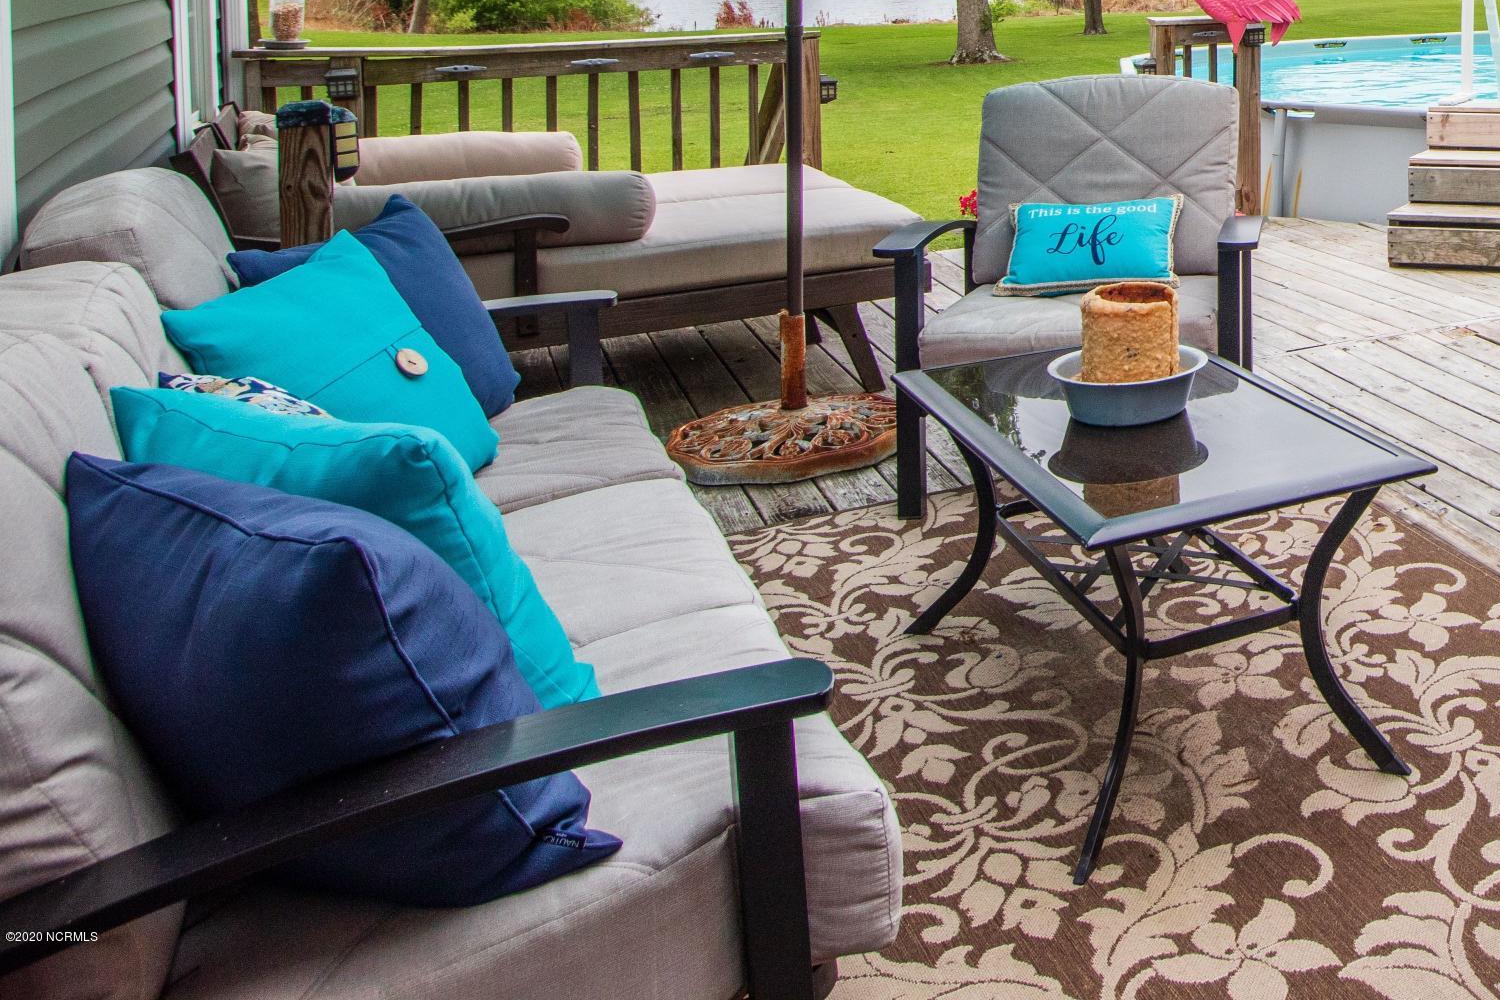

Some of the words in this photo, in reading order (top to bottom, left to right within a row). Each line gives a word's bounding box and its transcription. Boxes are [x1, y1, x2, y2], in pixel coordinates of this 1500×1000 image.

[1028, 206, 1062, 219] This
[1067, 205, 1081, 215] is
[1086, 204, 1113, 214] the
[1116, 203, 1157, 216] good
[1046, 214, 1125, 266] Life
